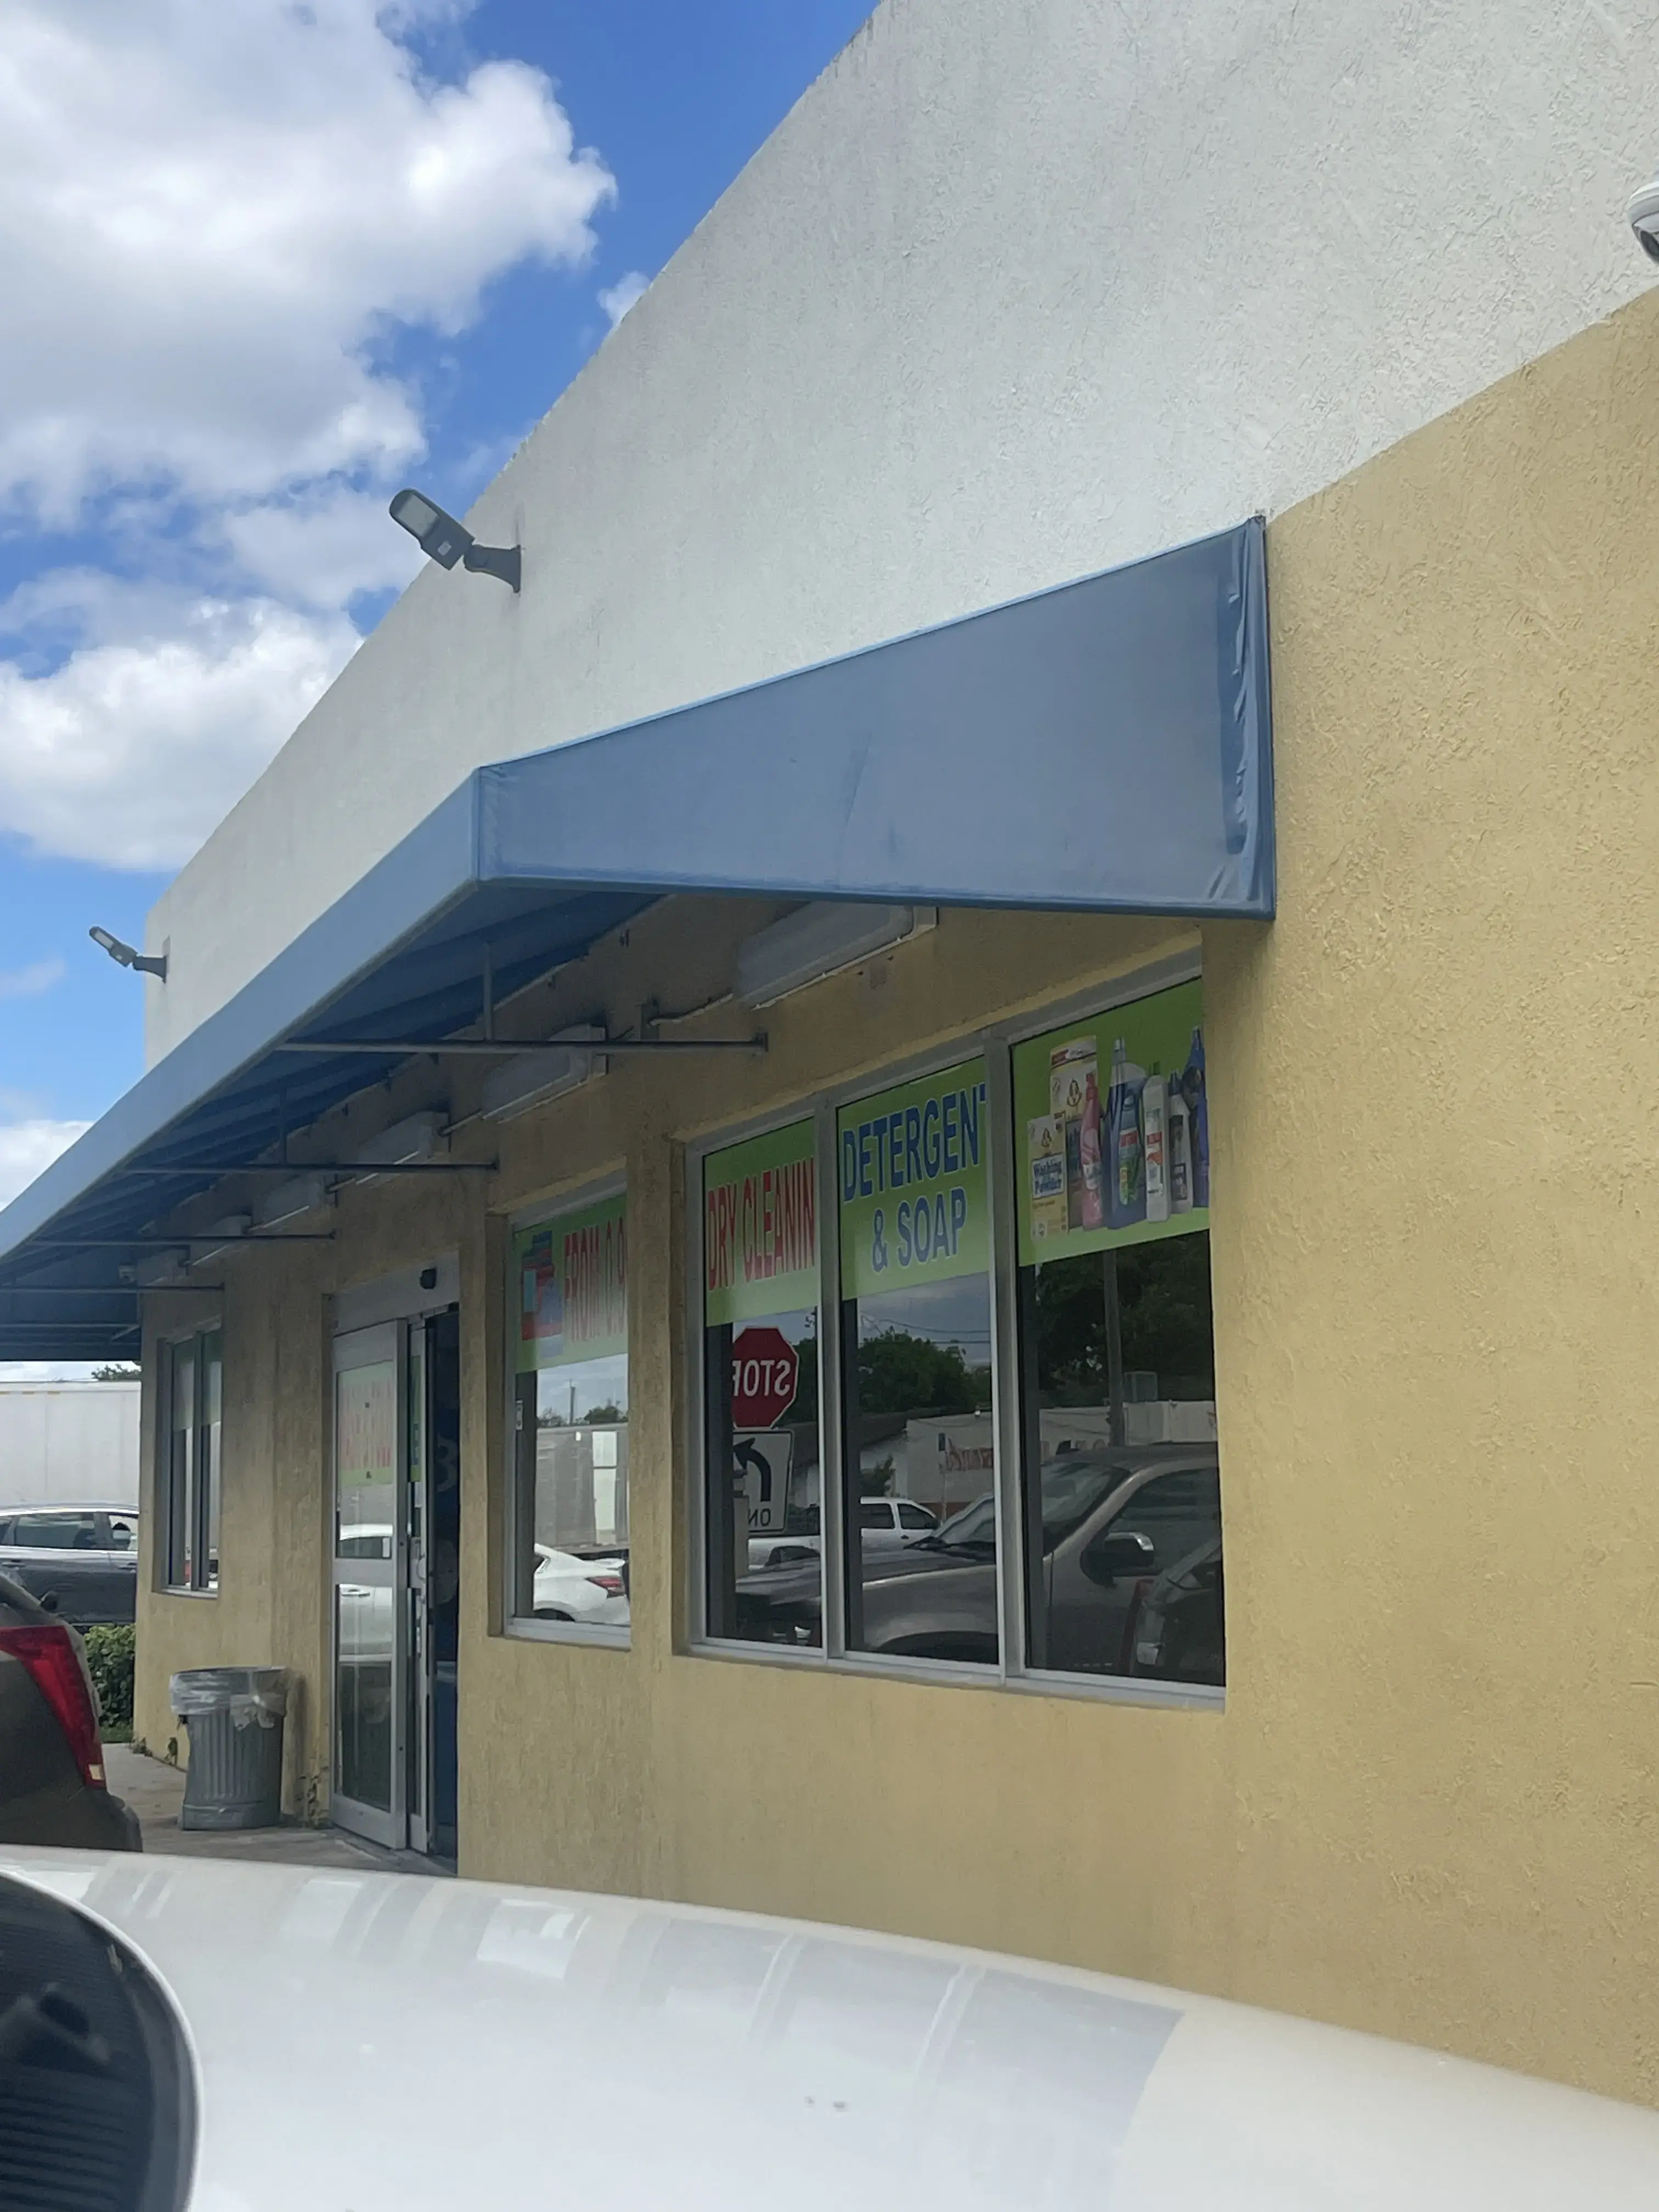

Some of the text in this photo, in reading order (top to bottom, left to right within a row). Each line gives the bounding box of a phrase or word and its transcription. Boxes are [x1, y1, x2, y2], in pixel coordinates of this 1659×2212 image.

[707, 1182, 737, 1290] DRY
[871, 1186, 967, 1274] & SOAP
